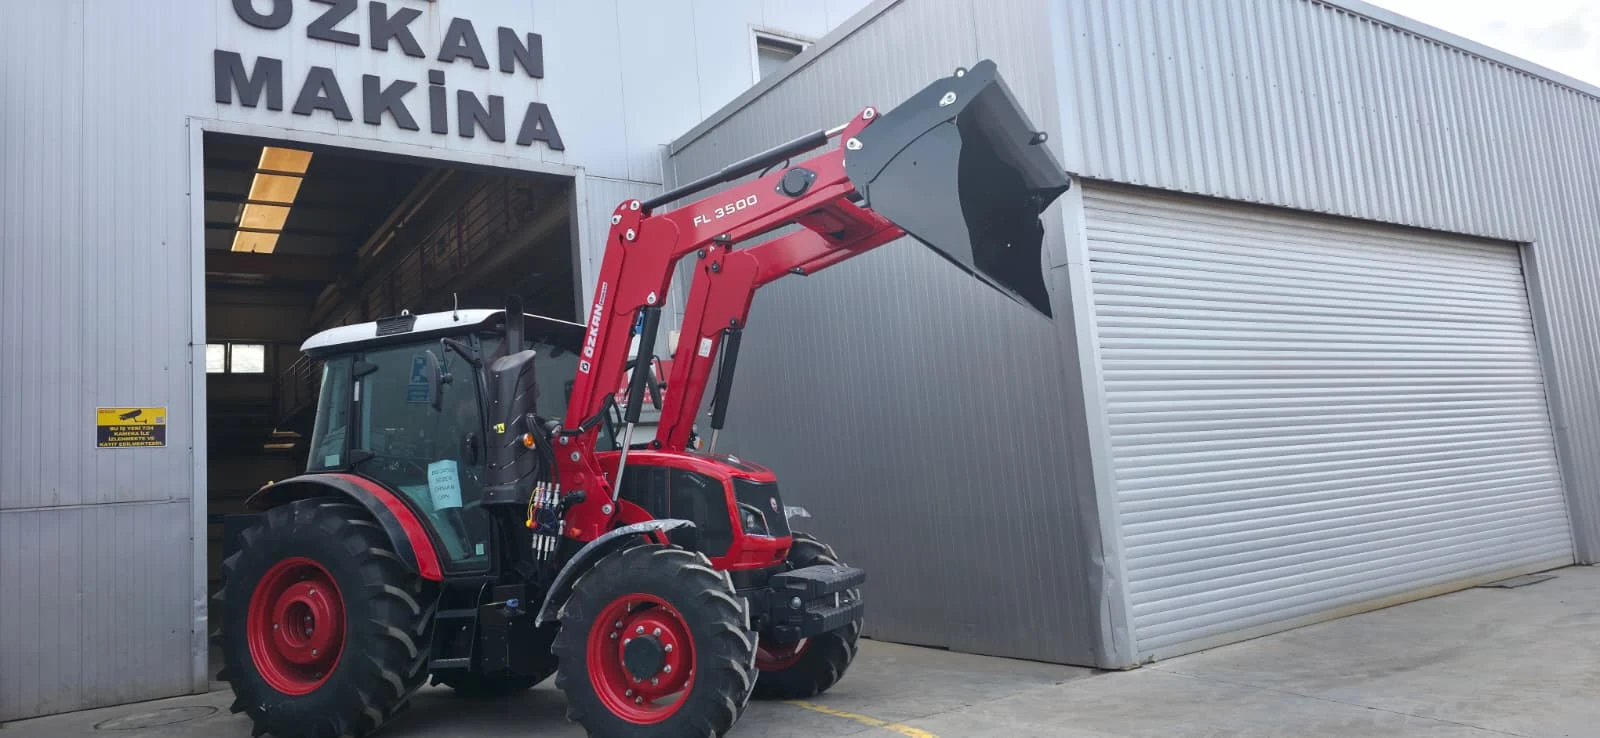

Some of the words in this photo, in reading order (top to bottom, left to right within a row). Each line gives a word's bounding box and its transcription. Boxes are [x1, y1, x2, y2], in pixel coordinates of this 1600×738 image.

[214, 49, 565, 151] MAKİNA
[693, 214, 712, 228] FL
[714, 194, 758, 219] 3500
[583, 303, 604, 359] ÖZKAN
